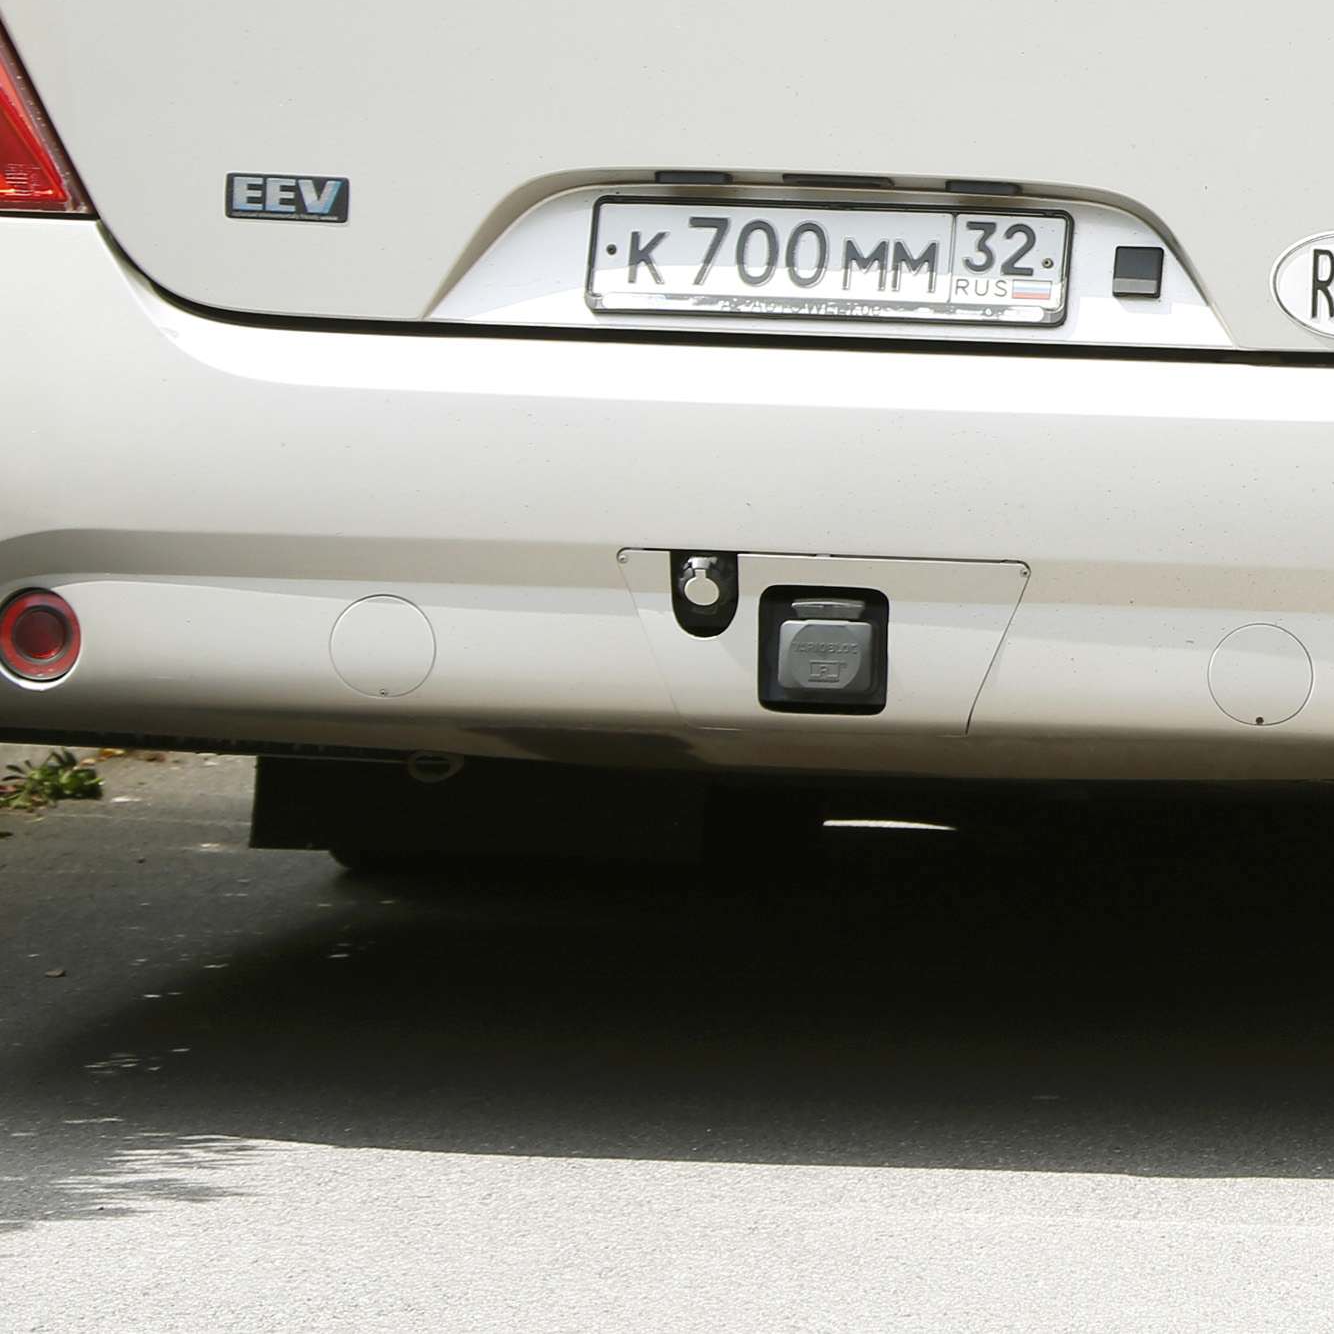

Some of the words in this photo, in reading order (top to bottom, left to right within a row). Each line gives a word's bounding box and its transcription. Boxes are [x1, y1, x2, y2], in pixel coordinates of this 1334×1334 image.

[231, 175, 343, 215] EEV
[961, 220, 1039, 277] 32
[955, 278, 1008, 298] RUS
